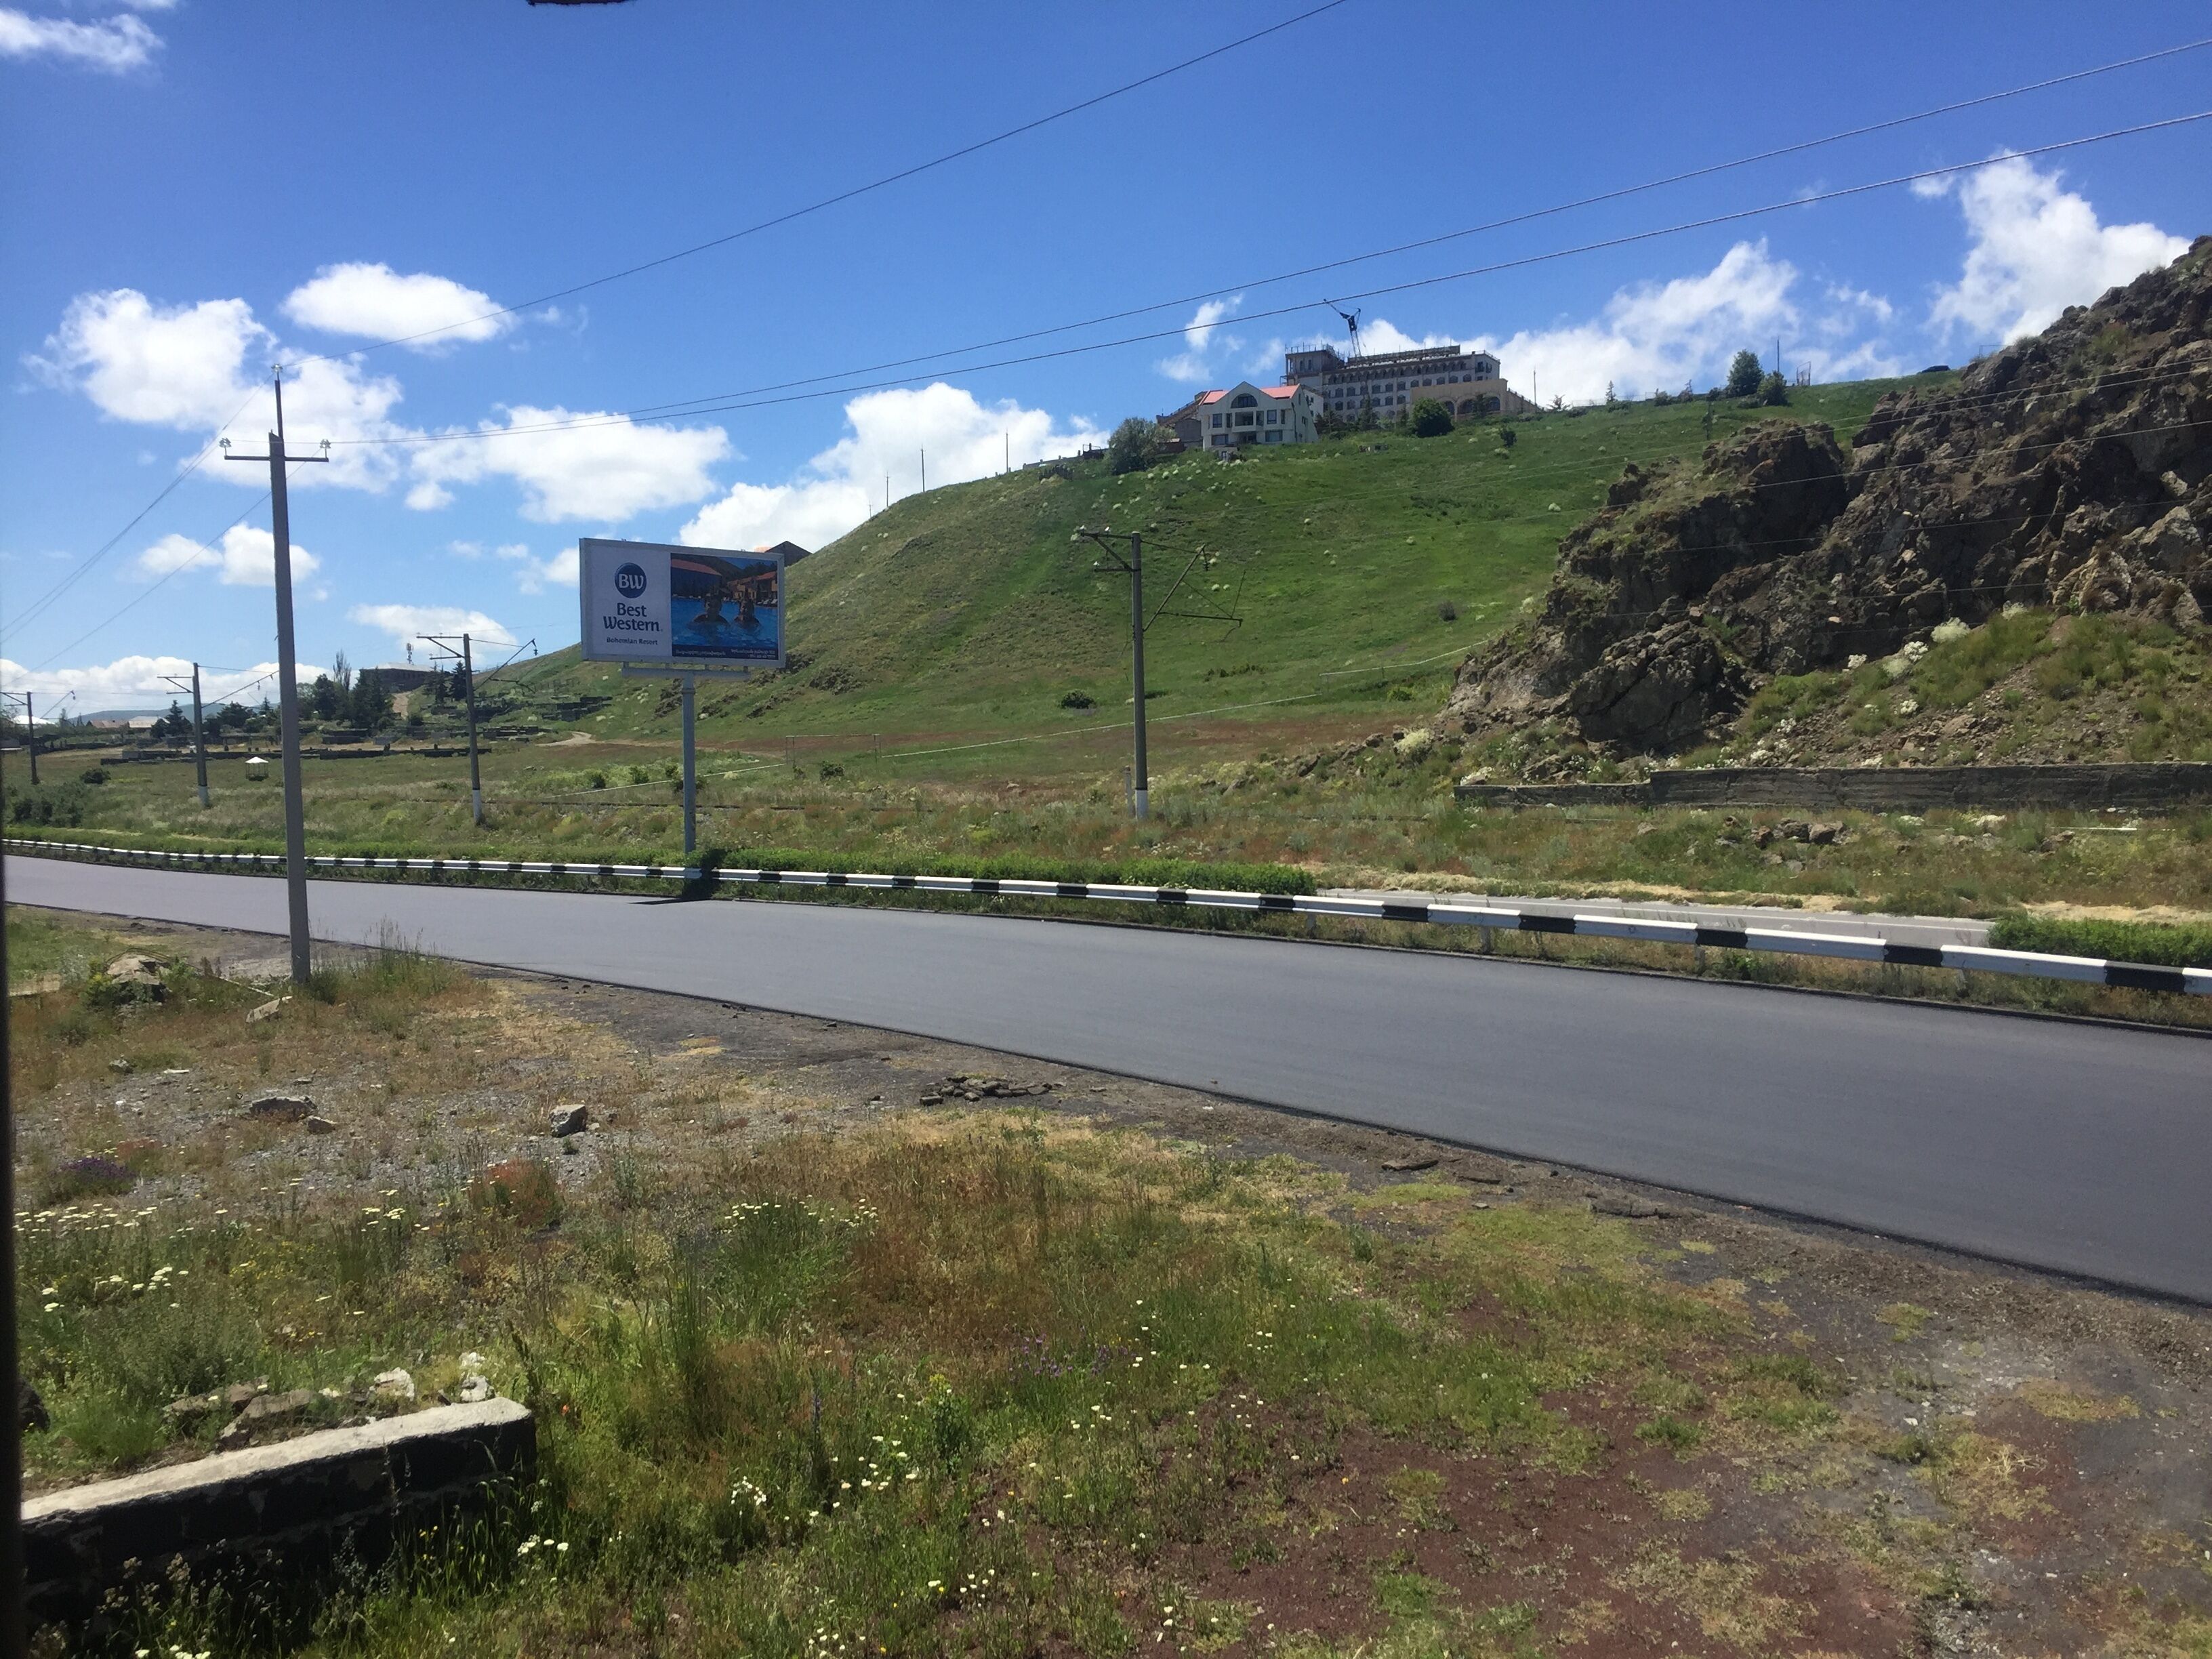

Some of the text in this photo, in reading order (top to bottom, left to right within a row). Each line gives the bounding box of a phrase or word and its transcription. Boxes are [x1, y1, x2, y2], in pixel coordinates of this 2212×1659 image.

[619, 574, 644, 589] BW
[617, 602, 647, 617] Best
[603, 616, 660, 632] Western
